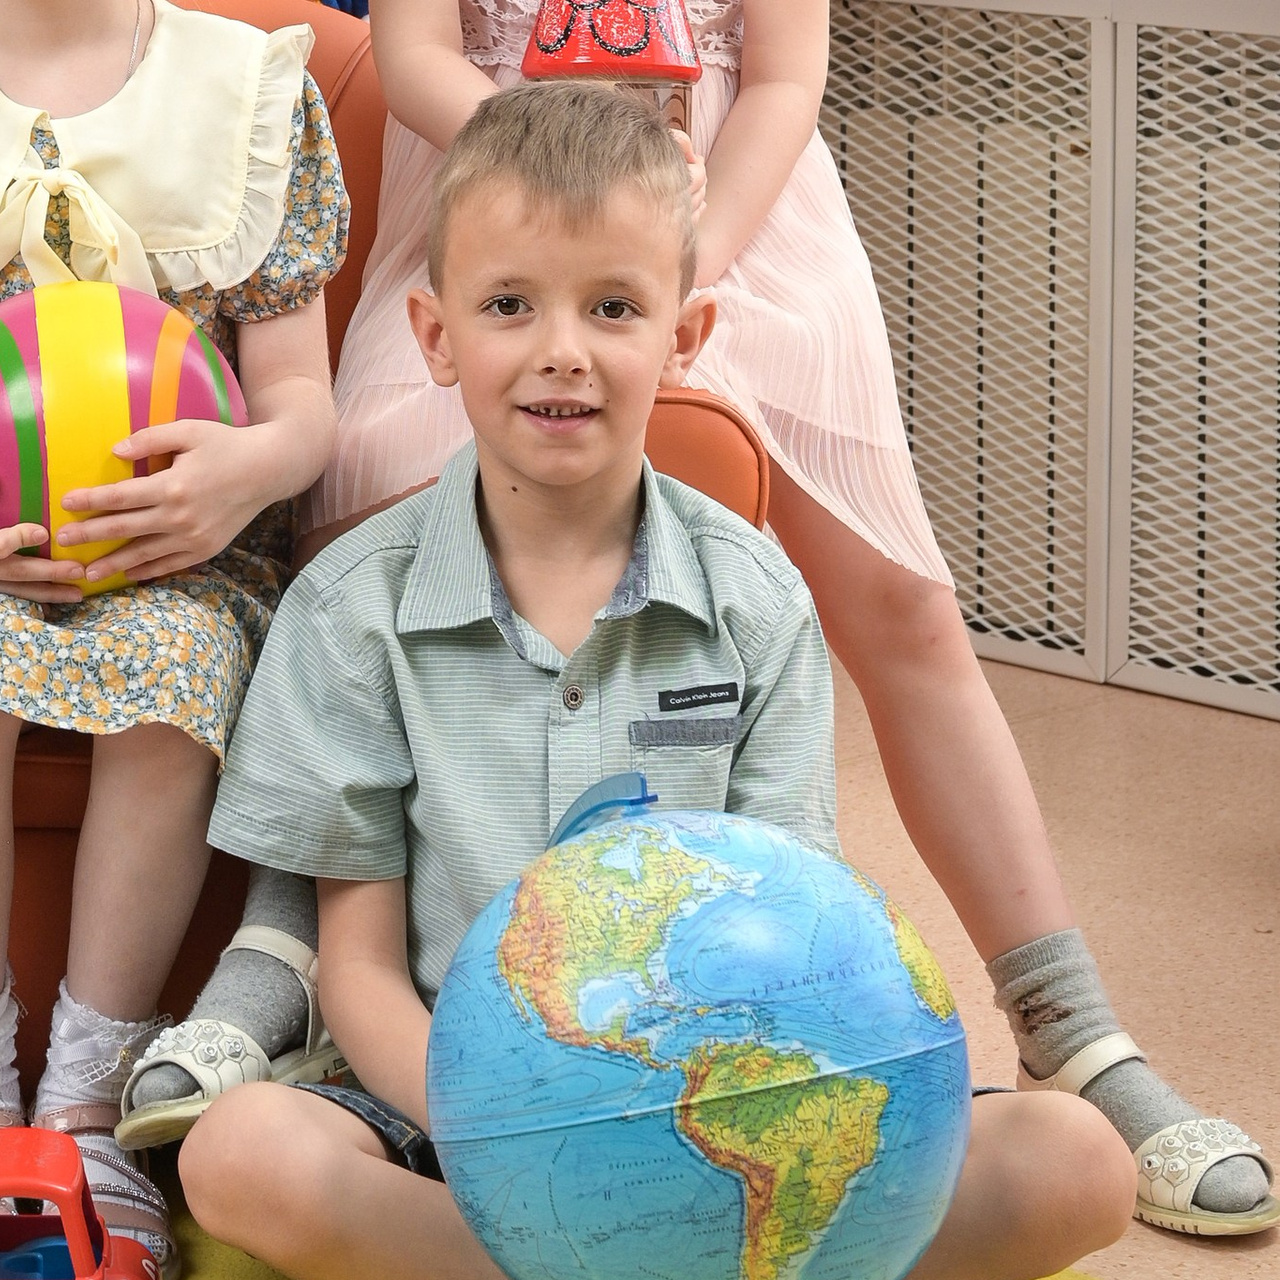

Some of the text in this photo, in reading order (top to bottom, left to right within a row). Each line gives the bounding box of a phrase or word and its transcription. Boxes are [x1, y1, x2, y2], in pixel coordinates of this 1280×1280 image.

[669, 691, 730, 705] Calvin Klein Jeans
